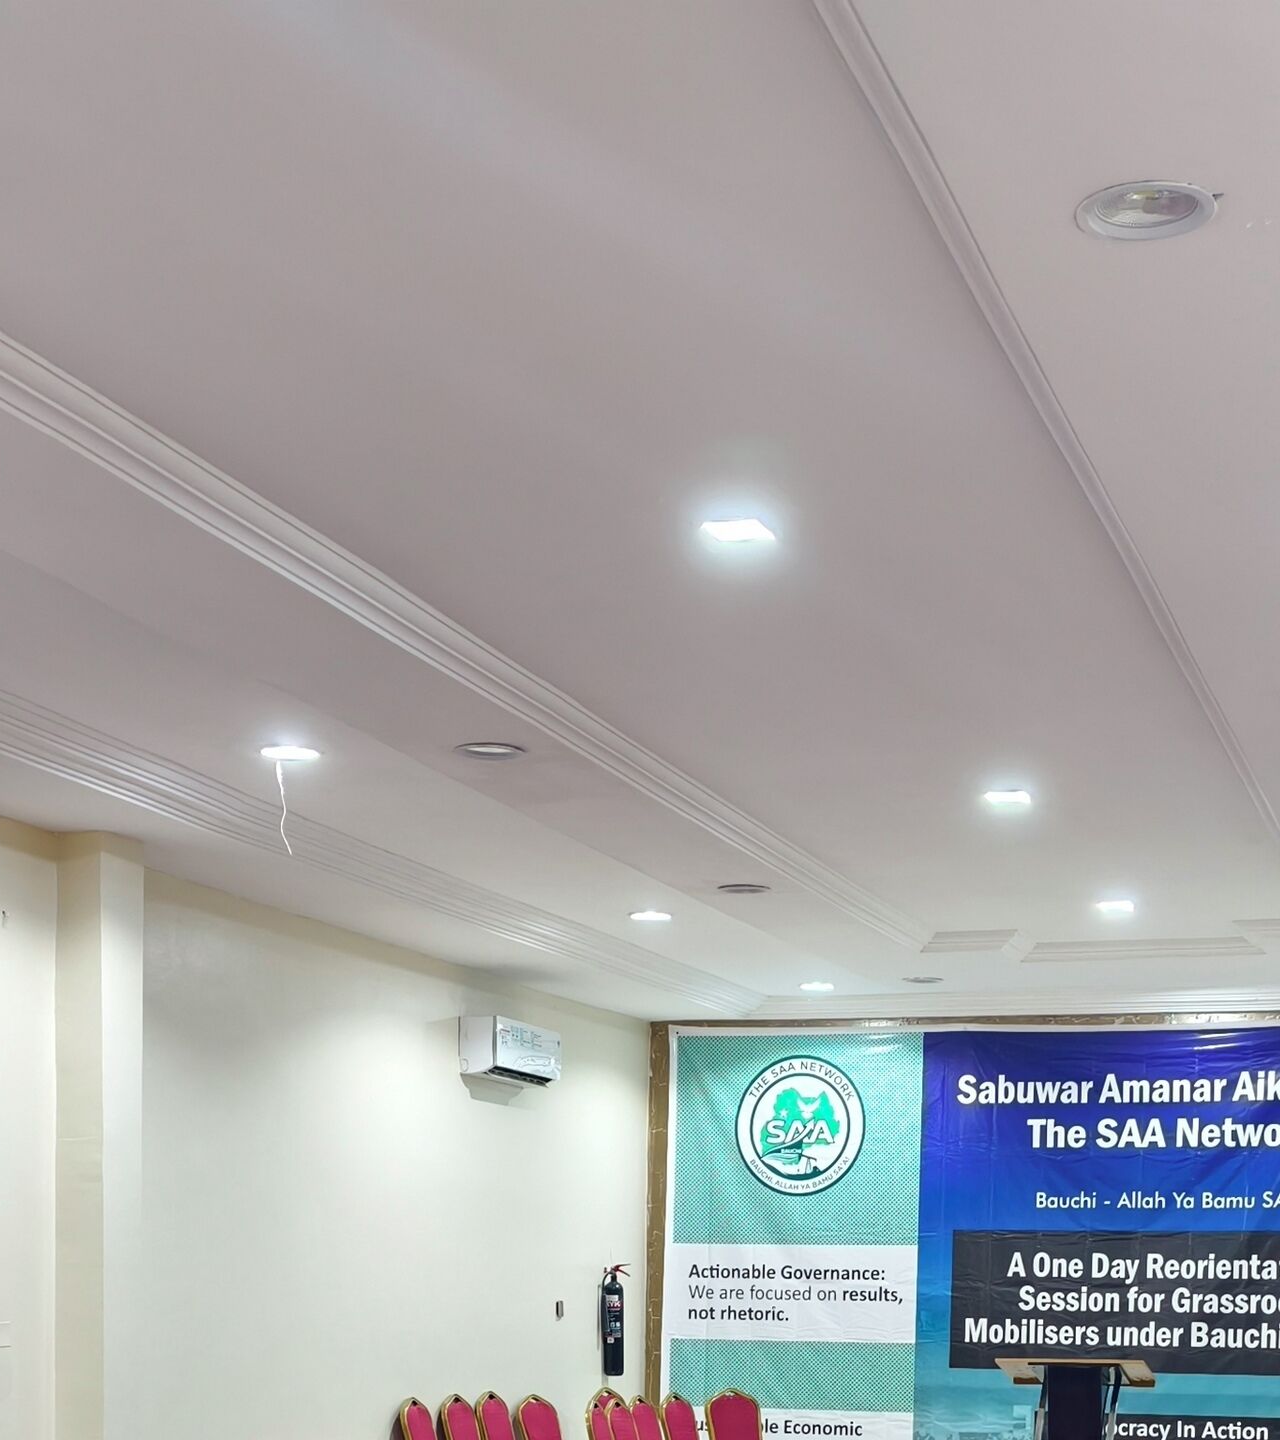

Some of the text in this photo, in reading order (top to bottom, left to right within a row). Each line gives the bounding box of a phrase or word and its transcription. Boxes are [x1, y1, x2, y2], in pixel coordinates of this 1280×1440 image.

[748, 1061, 855, 1102] THE SAA NETWORK
[956, 1073, 1094, 1105] Sabuwar
[1098, 1073, 1227, 1104] Amanar
[1026, 1118, 1087, 1149] The
[1095, 1117, 1167, 1149] SAA
[774, 1179, 800, 1191] ALLAH
[811, 1172, 834, 1189] BAMU
[1035, 1190, 1097, 1209] Bauchi
[1116, 1190, 1166, 1209] Allah
[1172, 1191, 1195, 1209] Ya
[1201, 1191, 1256, 1209] Bamu
[688, 1264, 886, 1281] Actionable Governance:
[1006, 1251, 1027, 1278] A
[1032, 1251, 1084, 1279] One
[1091, 1252, 1140, 1285] Day
[688, 1284, 904, 1305] We are focused on results,
[1017, 1284, 1120, 1312] Session
[1127, 1286, 1165, 1313] for
[688, 1305, 790, 1322] not rhetoric.
[963, 1317, 1100, 1346] Mobilisers
[1106, 1321, 1184, 1348] under
[783, 1419, 863, 1437] Economic
[1176, 1420, 1196, 1439] In
